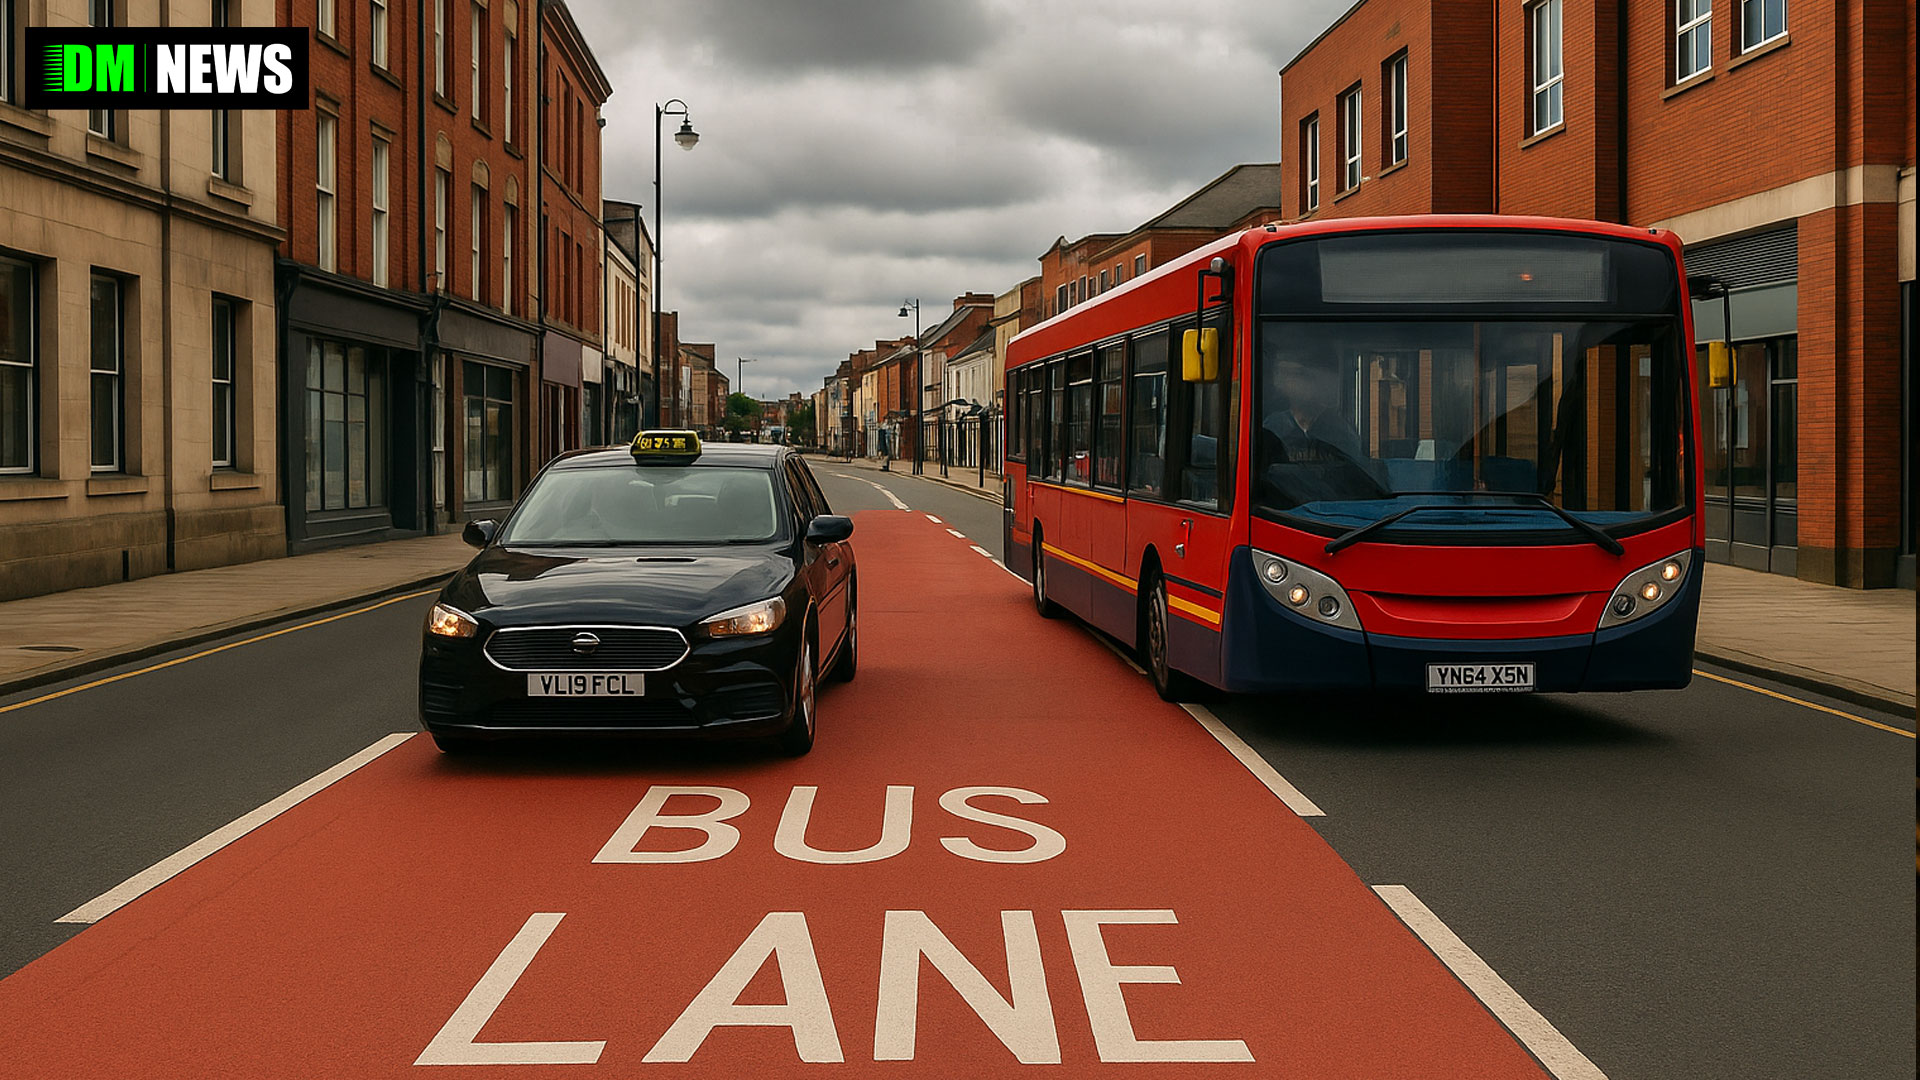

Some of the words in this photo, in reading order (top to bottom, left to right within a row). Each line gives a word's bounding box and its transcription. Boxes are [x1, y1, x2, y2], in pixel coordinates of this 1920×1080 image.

[540, 675, 588, 695] VL19
[591, 675, 635, 695] FCL
[1437, 666, 1488, 685] YN64
[1490, 666, 1529, 685] X5N
[591, 785, 1067, 865] BUS
[412, 909, 1256, 1066] LANE
